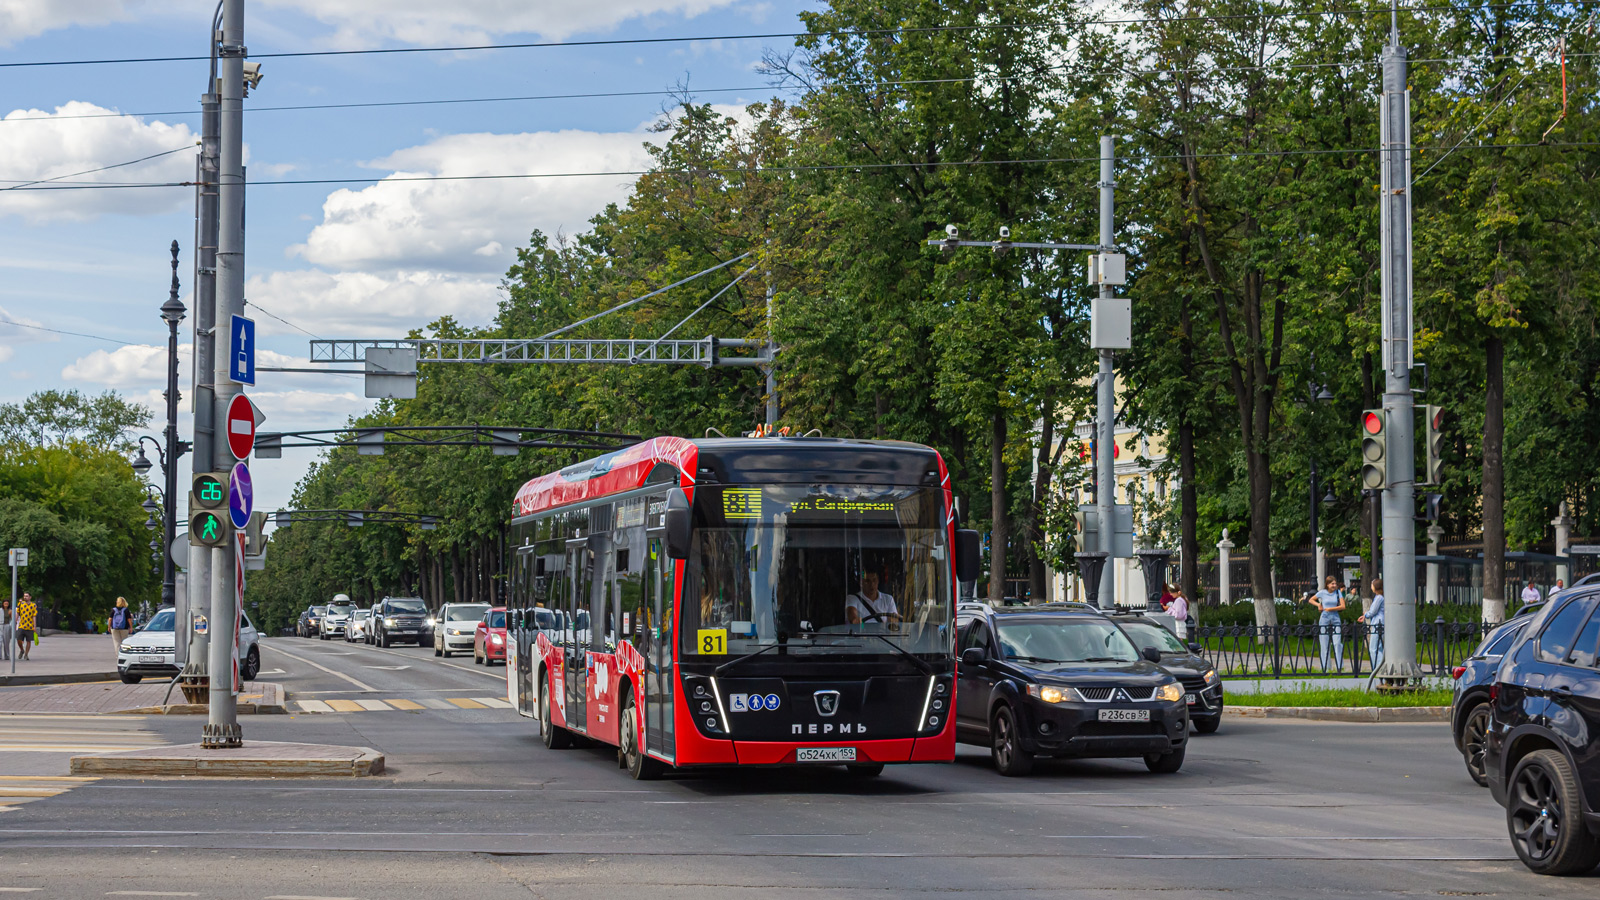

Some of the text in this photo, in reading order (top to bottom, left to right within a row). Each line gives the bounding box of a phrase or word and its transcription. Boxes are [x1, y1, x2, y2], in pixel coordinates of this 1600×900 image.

[201, 482, 222, 500] 26
[703, 635, 722, 653] 81
[1138, 710, 1147, 718] 59
[791, 723, 867, 734] ПЕРМЬ
[800, 748, 853, 760] О524ХК 159
